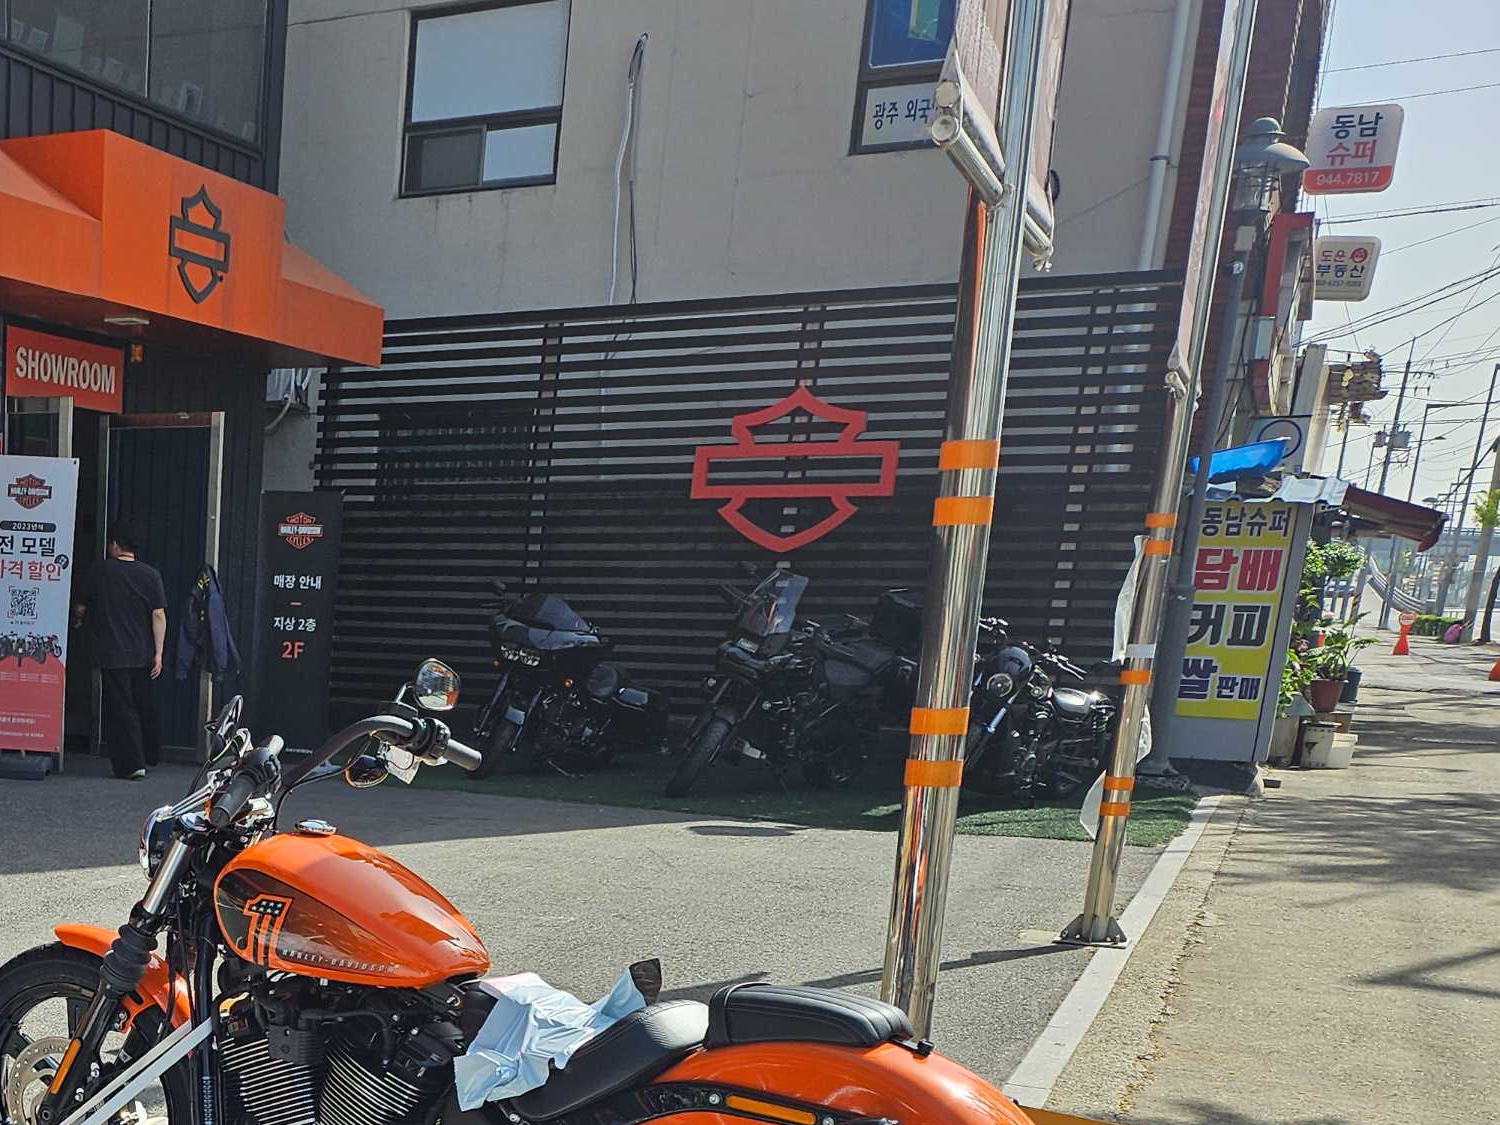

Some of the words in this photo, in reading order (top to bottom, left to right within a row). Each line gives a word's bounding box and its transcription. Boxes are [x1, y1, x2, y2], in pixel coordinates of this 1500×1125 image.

[873, 101, 899, 130] 광주
[905, 98, 936, 124] 외국
[1331, 112, 1383, 139] 동남
[1326, 139, 1377, 166] 슈퍼
[1316, 172, 1380, 186] 944.7817
[1316, 264, 1365, 278] 부동산
[15, 346, 116, 395] SHOWROOM
[12, 522, 44, 531] 2023년식
[1201, 506, 1293, 538] 동남슈퍼
[20, 537, 56, 557] 모델
[28, 561, 61, 581] 할인
[273, 574, 296, 589] 매장
[299, 575, 322, 590] 안내
[1194, 548, 1284, 591] 담배
[273, 617, 296, 631] 지상
[297, 618, 317, 632] 2층
[1187, 604, 1271, 647] 커피
[281, 641, 305, 659] 2F
[1179, 657, 1218, 700] 쌀
[1216, 676, 1261, 701] 판매
[281, 948, 396, 973] HARLEY-DAVIDSON
